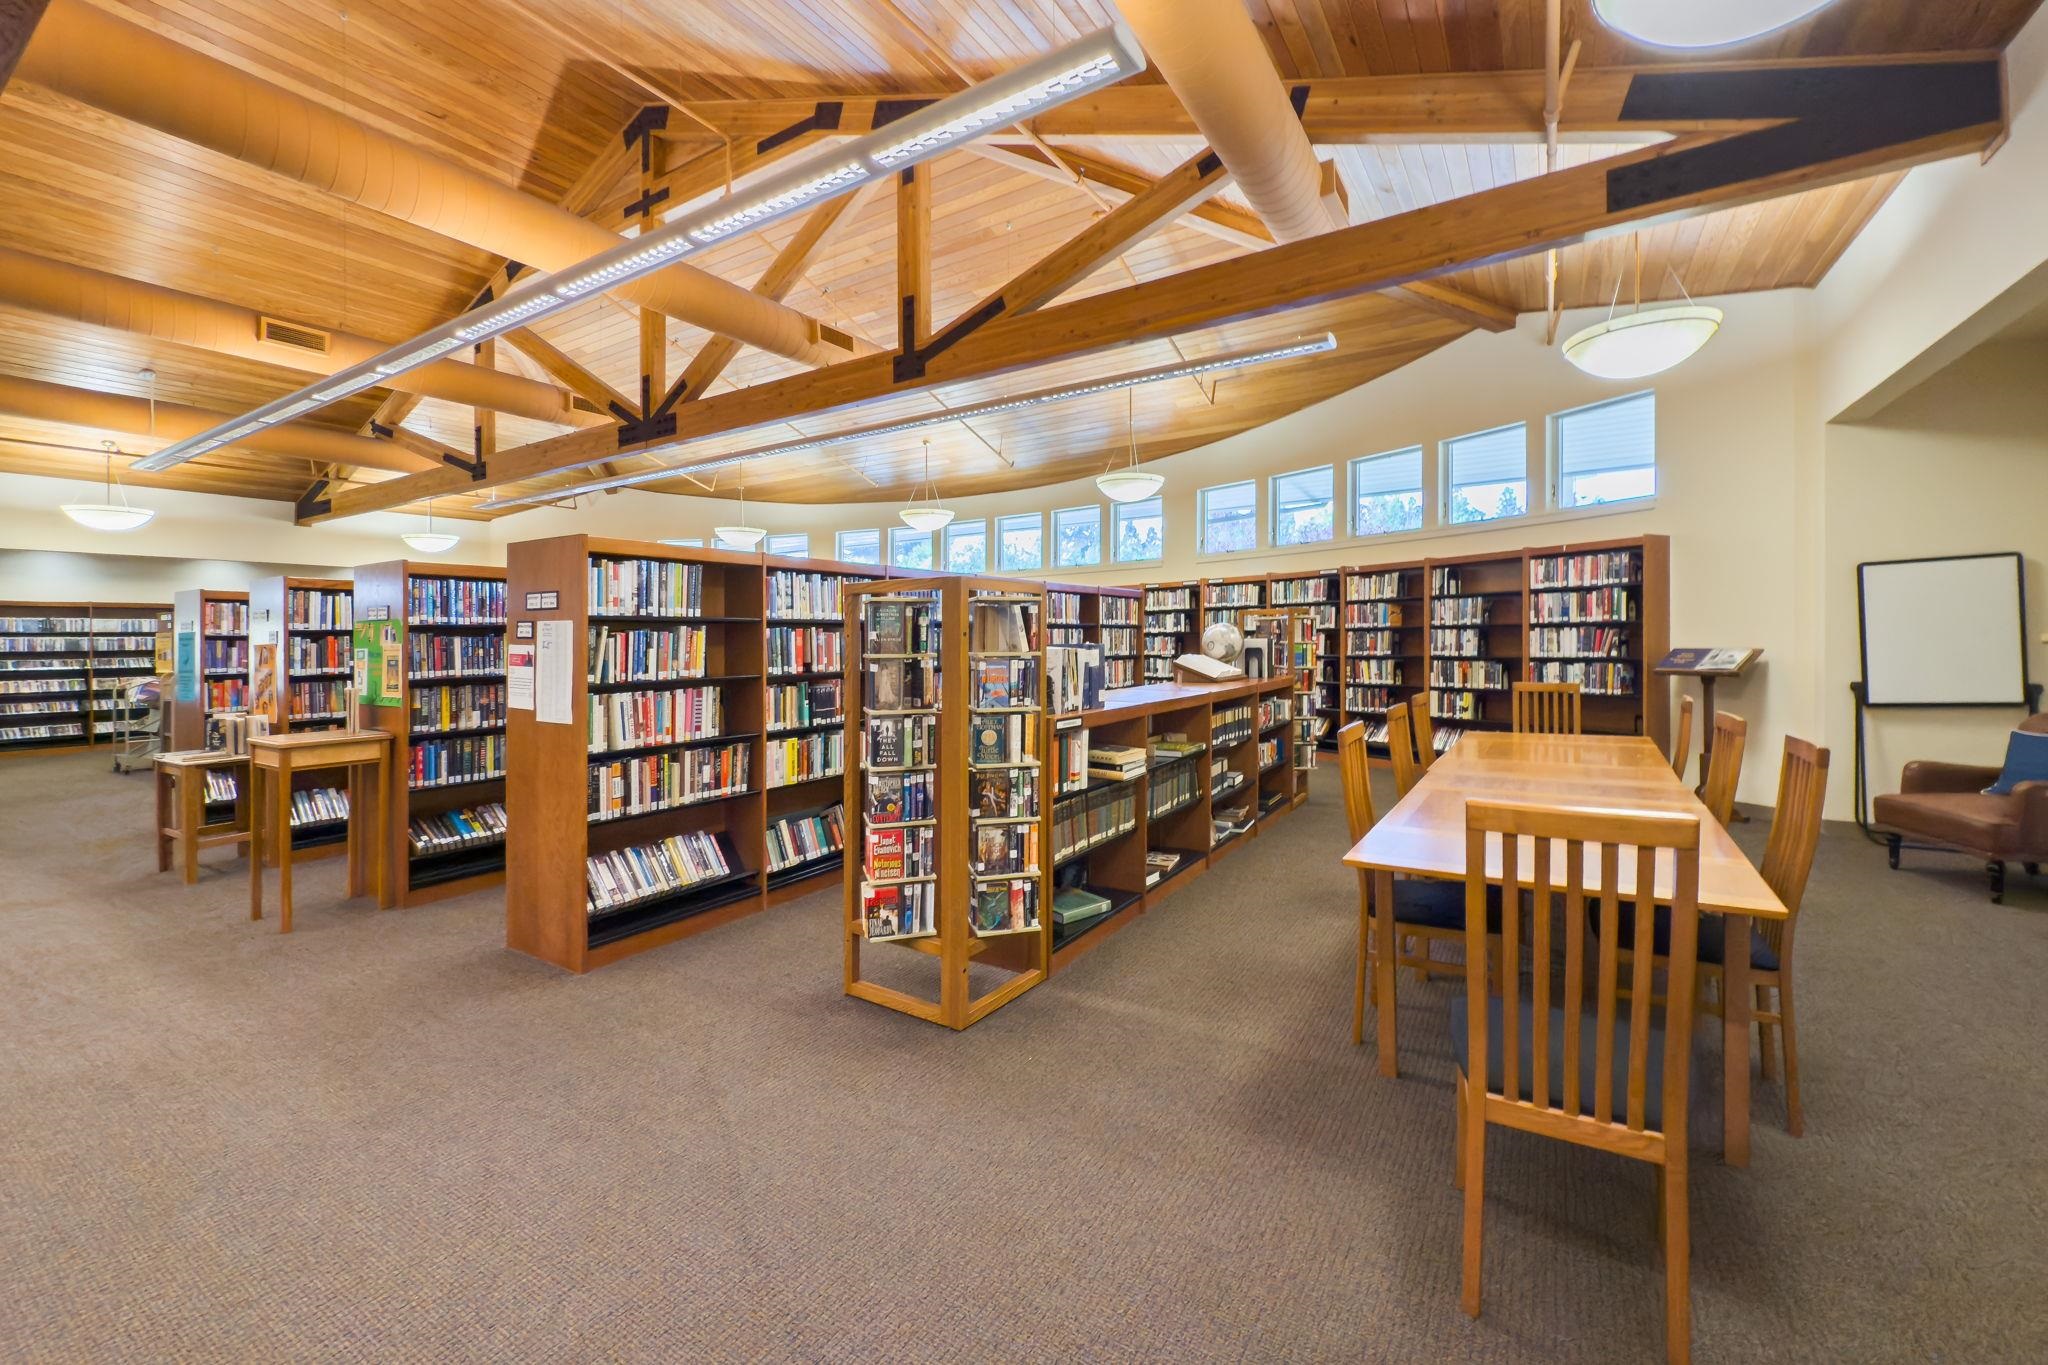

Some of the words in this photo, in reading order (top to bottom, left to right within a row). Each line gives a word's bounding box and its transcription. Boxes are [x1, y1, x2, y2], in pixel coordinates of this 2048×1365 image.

[880, 834, 896, 846] Janet
[874, 843, 901, 855] Evanovich
[874, 858, 901, 869] Notorious
